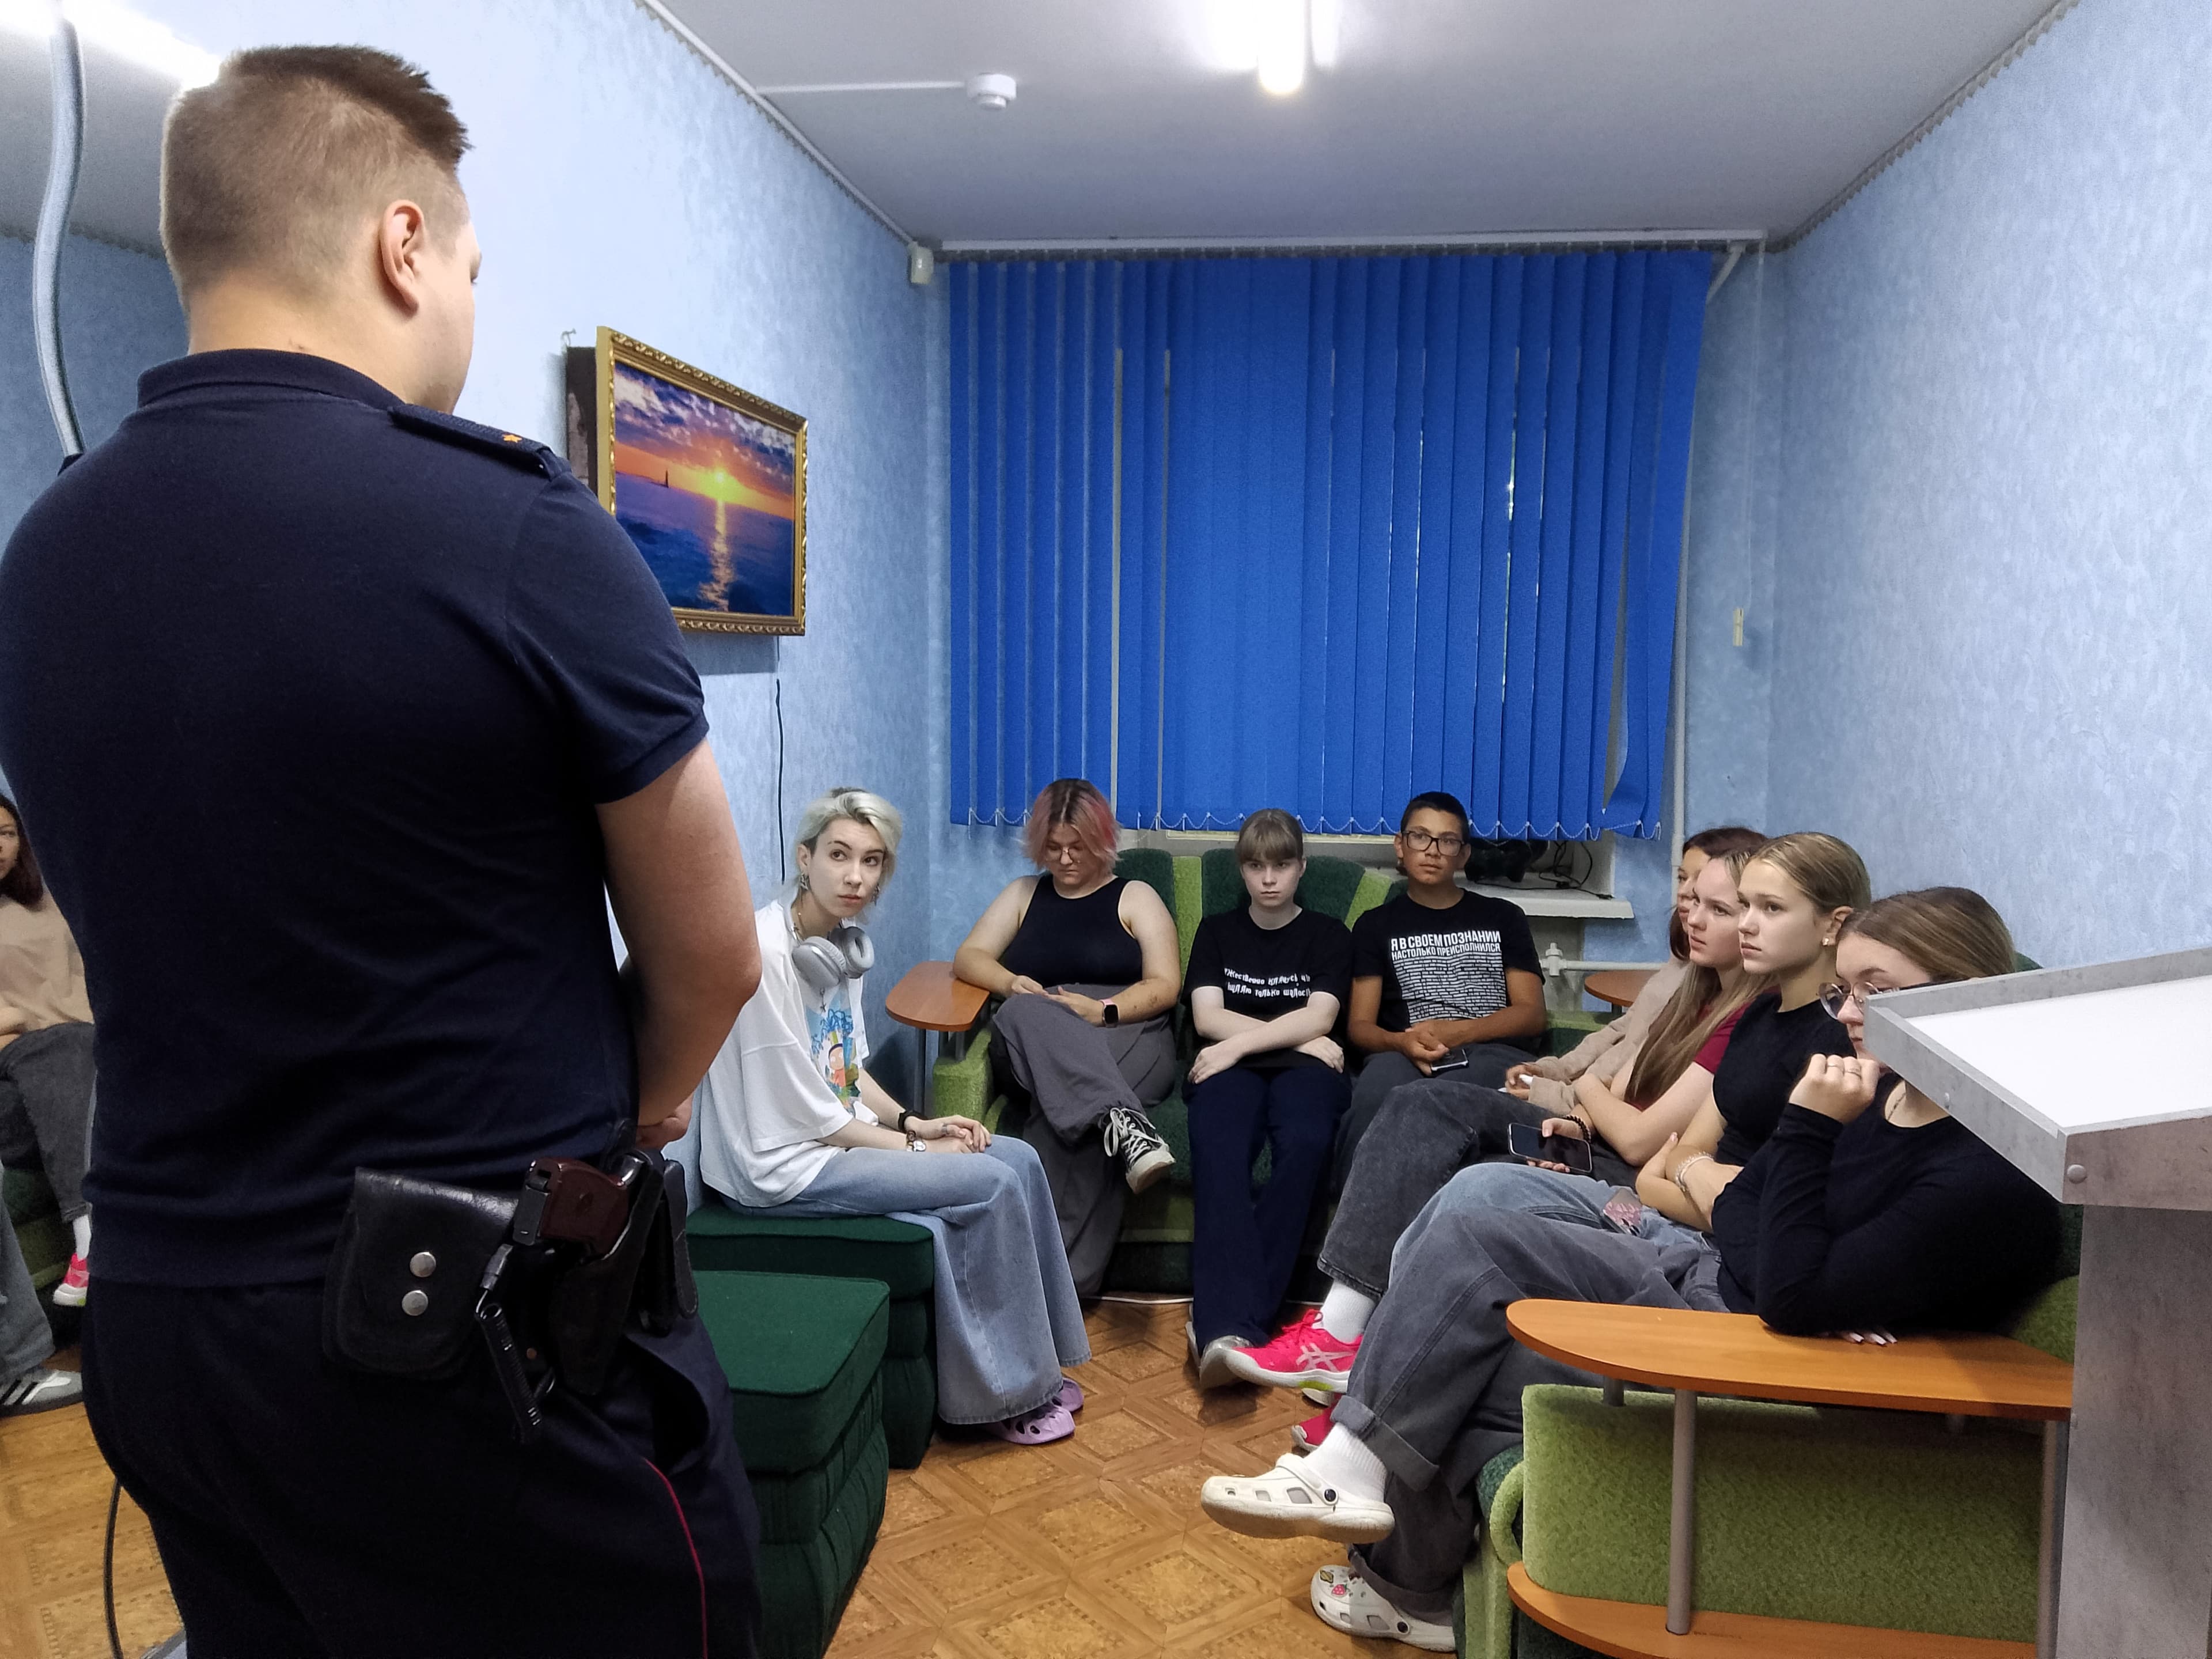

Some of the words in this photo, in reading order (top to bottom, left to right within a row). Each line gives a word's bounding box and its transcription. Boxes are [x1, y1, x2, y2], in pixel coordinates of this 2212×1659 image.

[1391, 938, 1399, 951] Я
[1399, 937, 1407, 949] В
[1407, 933, 1443, 948] СВОЕМ
[1443, 930, 1501, 946] ПОЗНАНИИ
[1391, 946, 1436, 961] НАСТОЛЬКО
[1437, 942, 1501, 956] ПРЕИСПОЛНИЛСЯ
